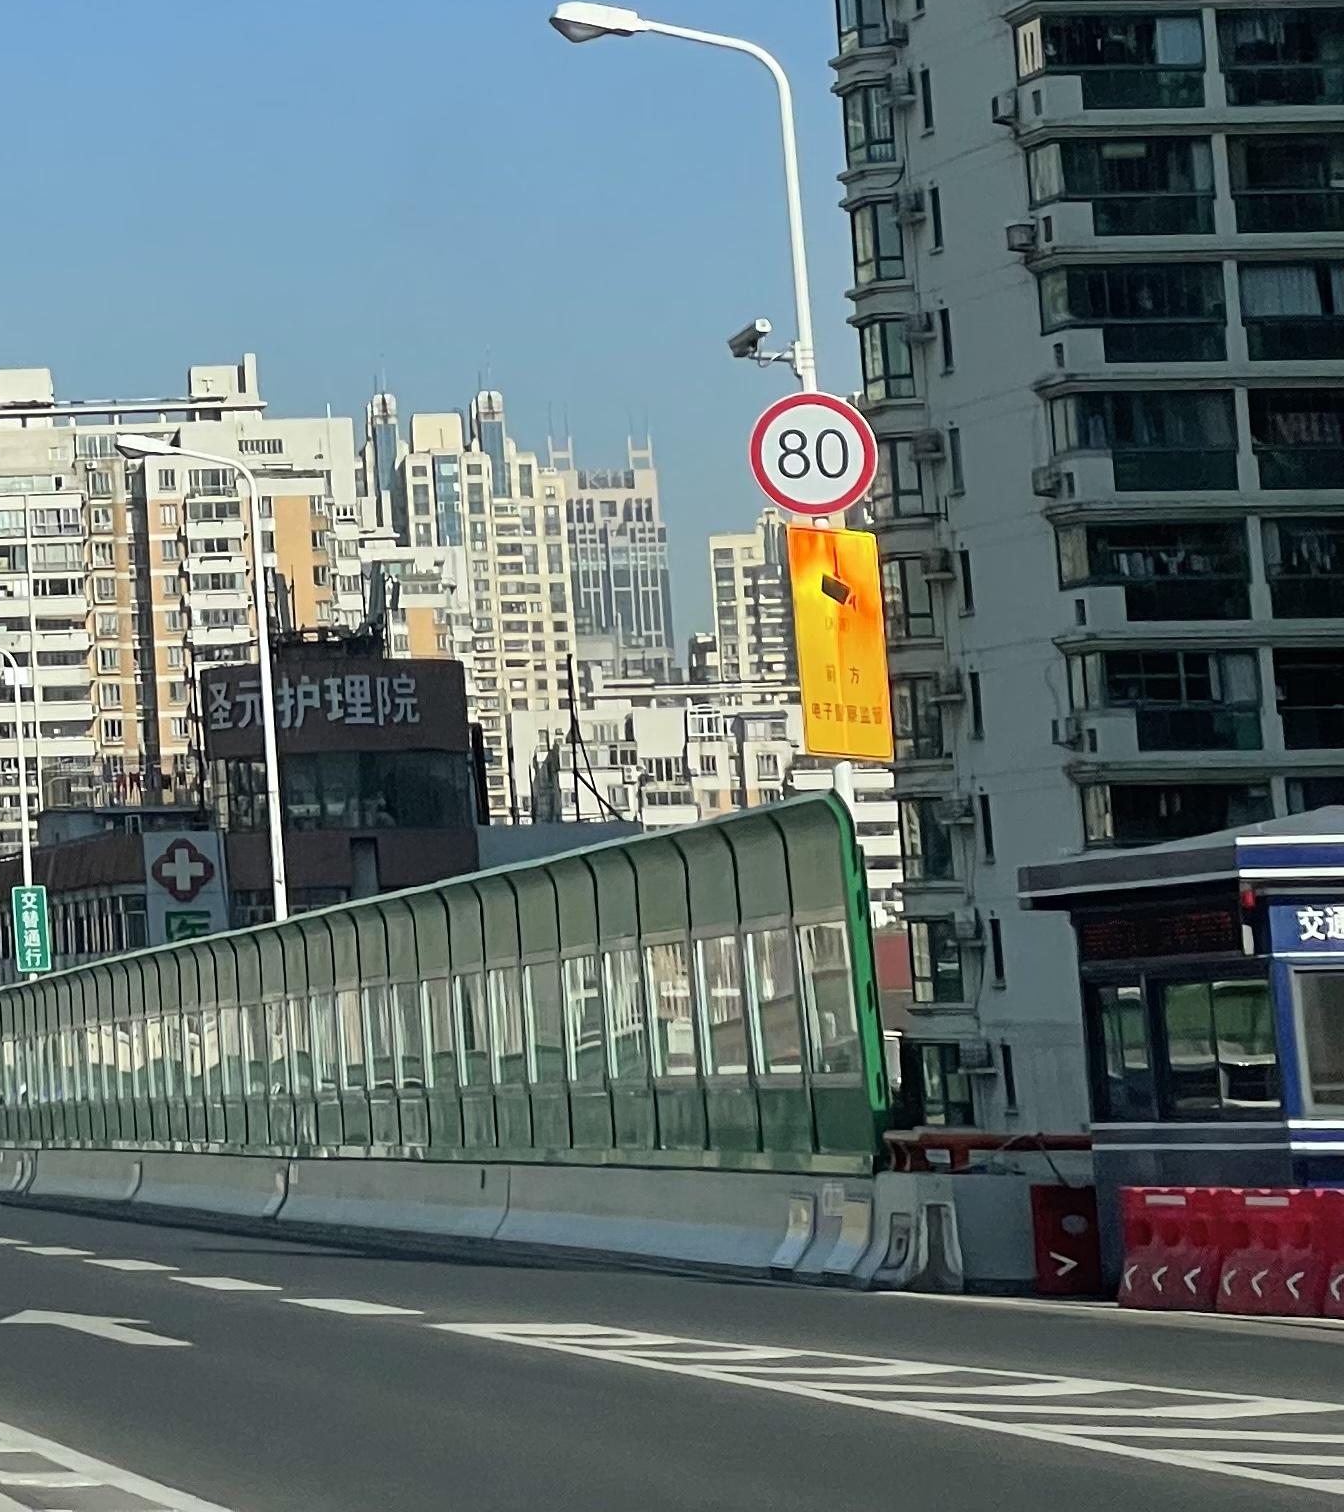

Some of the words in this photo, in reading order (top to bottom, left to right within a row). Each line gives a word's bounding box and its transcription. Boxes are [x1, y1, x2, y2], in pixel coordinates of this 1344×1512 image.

[778, 429, 849, 479] 80
[209, 673, 421, 731] 圣元护理院
[20, 892, 42, 967] 交替通行
